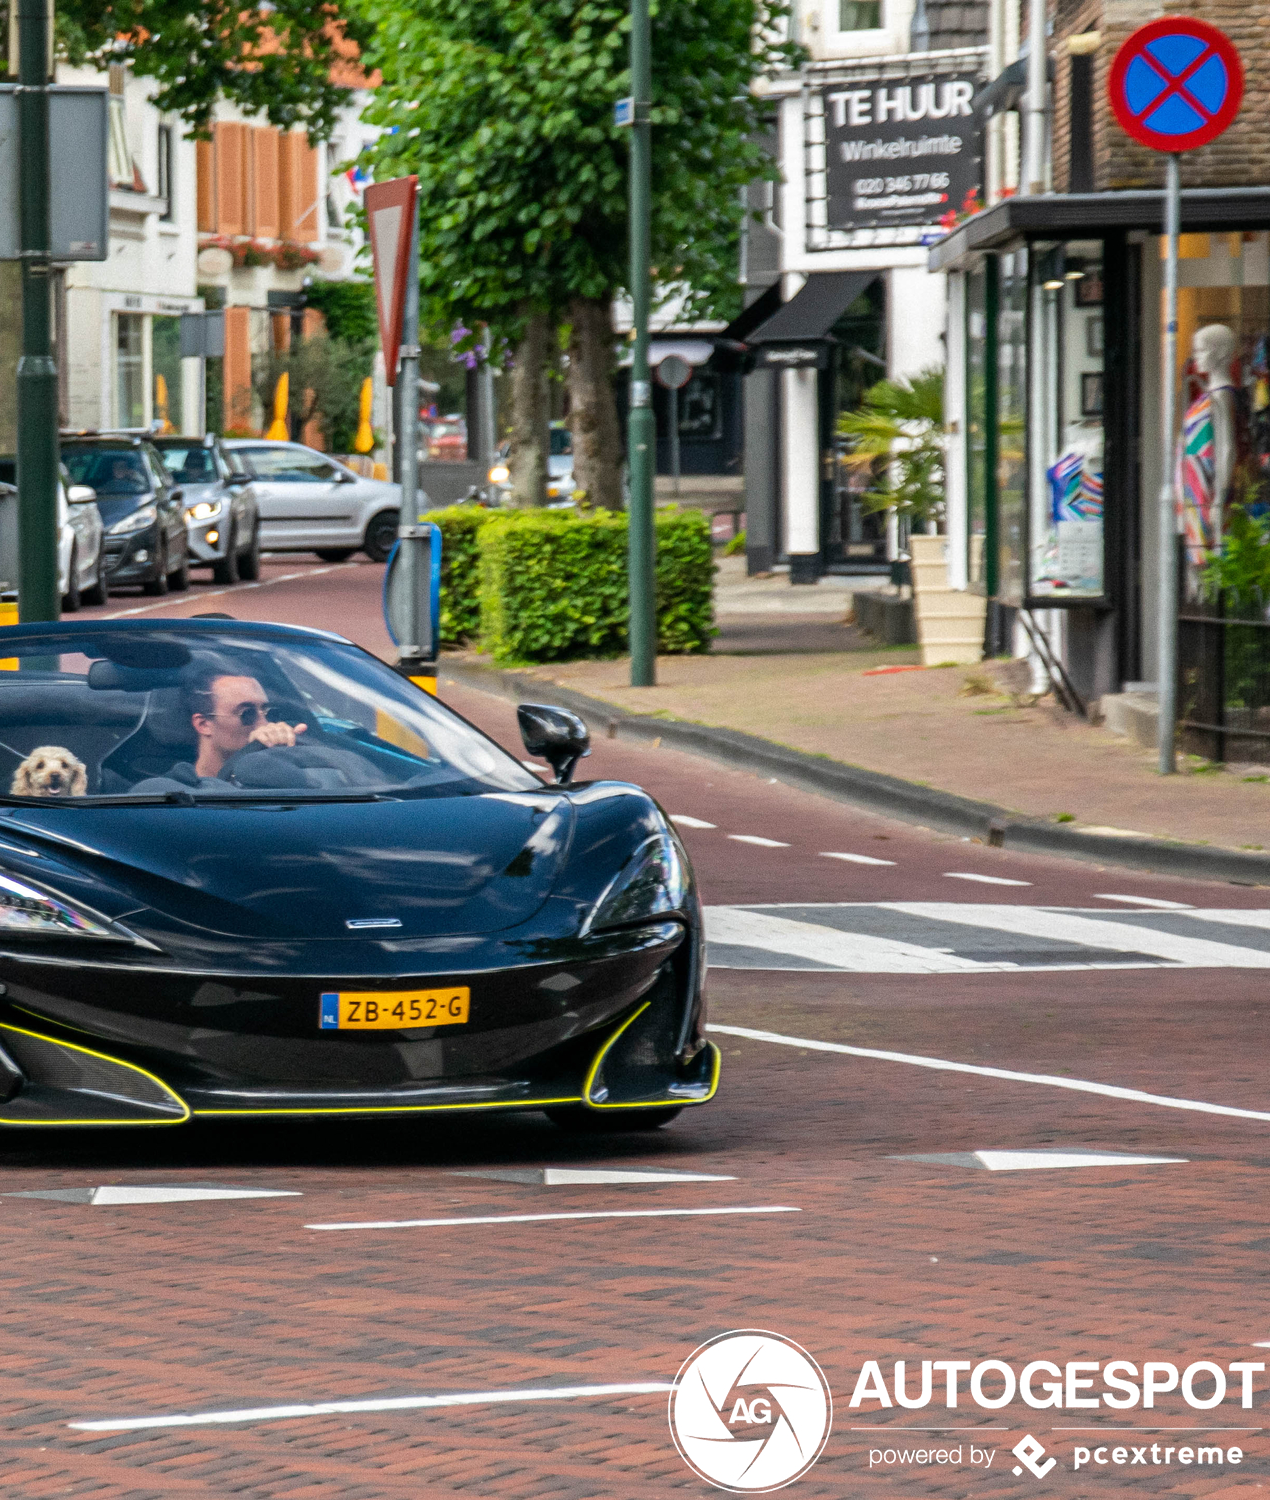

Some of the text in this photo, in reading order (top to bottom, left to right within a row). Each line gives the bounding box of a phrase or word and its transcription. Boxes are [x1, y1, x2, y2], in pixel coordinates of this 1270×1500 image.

[828, 80, 974, 128] TE HUUR
[840, 134, 963, 163] Winkelruimte
[854, 177, 884, 196] 020
[323, 995, 462, 1024] NL ZB-452-G
